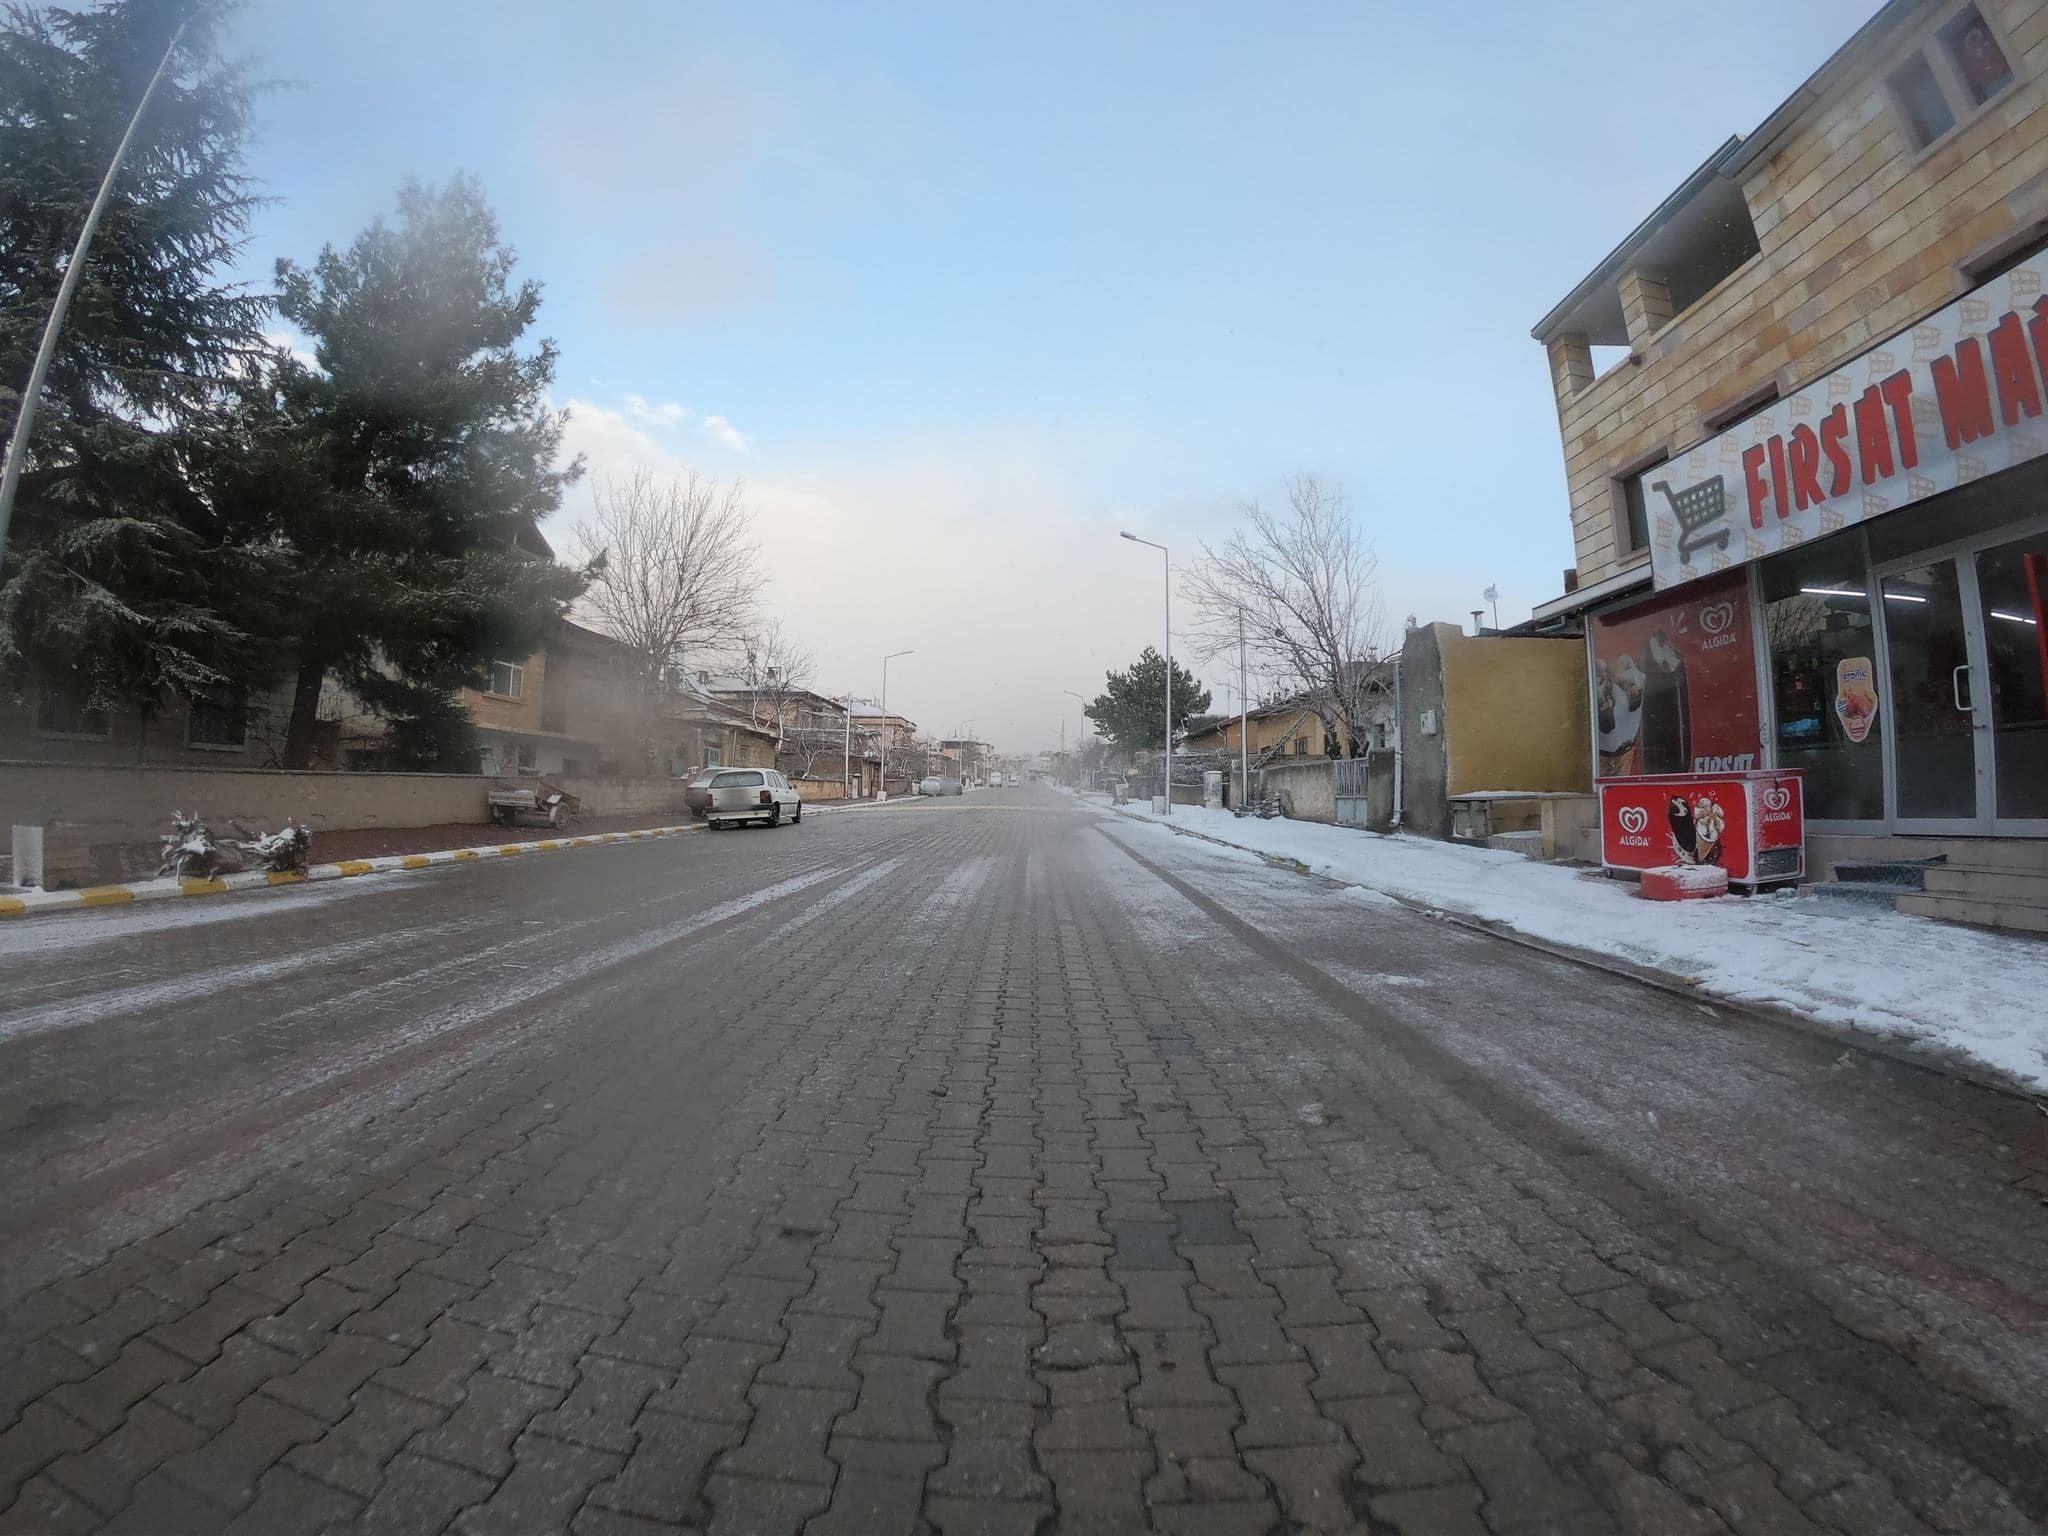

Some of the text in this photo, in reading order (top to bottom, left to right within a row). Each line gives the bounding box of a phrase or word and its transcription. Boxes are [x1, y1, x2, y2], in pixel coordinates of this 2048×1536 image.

[1743, 368, 1918, 529] FIRSAT
[1702, 633, 1737, 650] ALGIDA
[1762, 811, 1791, 822] ALGIDA
[1620, 835, 1650, 847] ALGIDA
